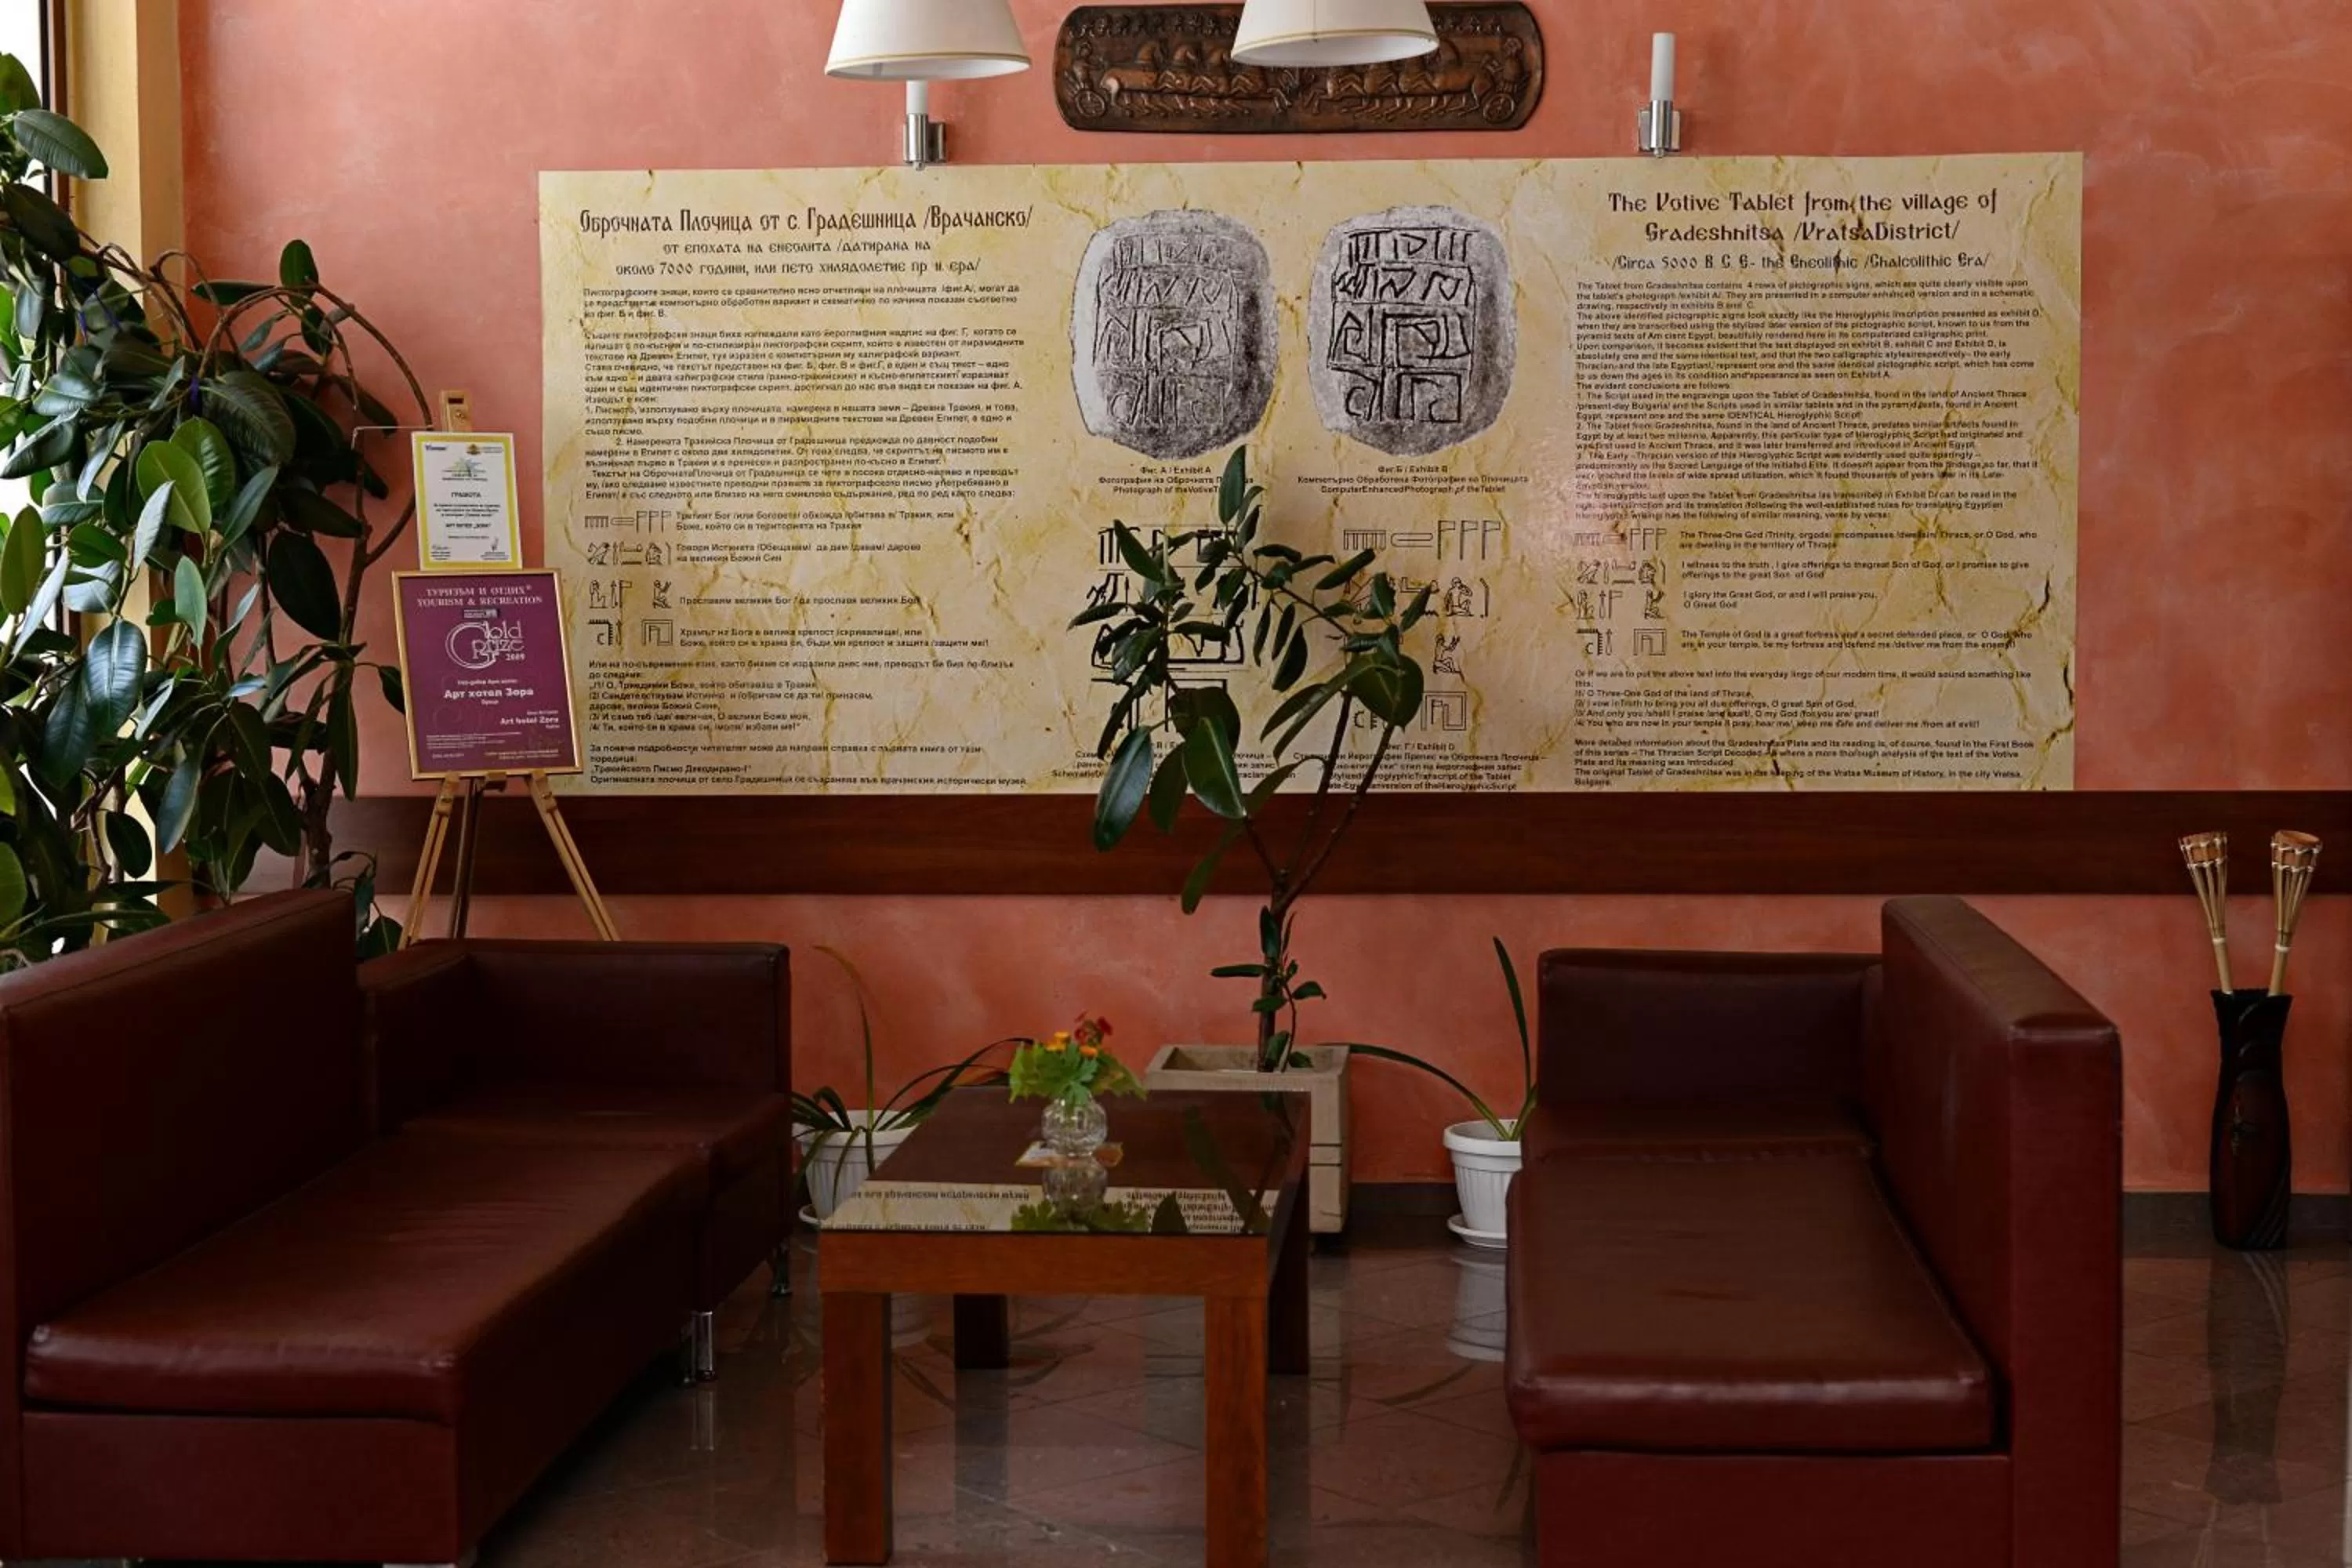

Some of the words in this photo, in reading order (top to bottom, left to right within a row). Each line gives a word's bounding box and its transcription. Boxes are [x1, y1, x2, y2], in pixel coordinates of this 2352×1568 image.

[1608, 193, 1646, 212] The
[1657, 193, 1719, 211] Votive
[1729, 192, 1794, 210] Tablet
[1806, 191, 1849, 216] from
[1860, 195, 1892, 211] the
[1901, 194, 1968, 214] village
[1977, 188, 1997, 214] of
[579, 210, 673, 238] Оброчната
[680, 209, 753, 233] Плочица
[760, 215, 780, 230] от
[808, 208, 916, 236] Градешница
[923, 205, 1033, 234] /Врачанско/
[1645, 223, 1784, 241] Gradeshnitsa
[662, 245, 680, 254] от
[684, 244, 742, 253] епохата
[837, 240, 909, 253] /датирана
[915, 241, 931, 250] на
